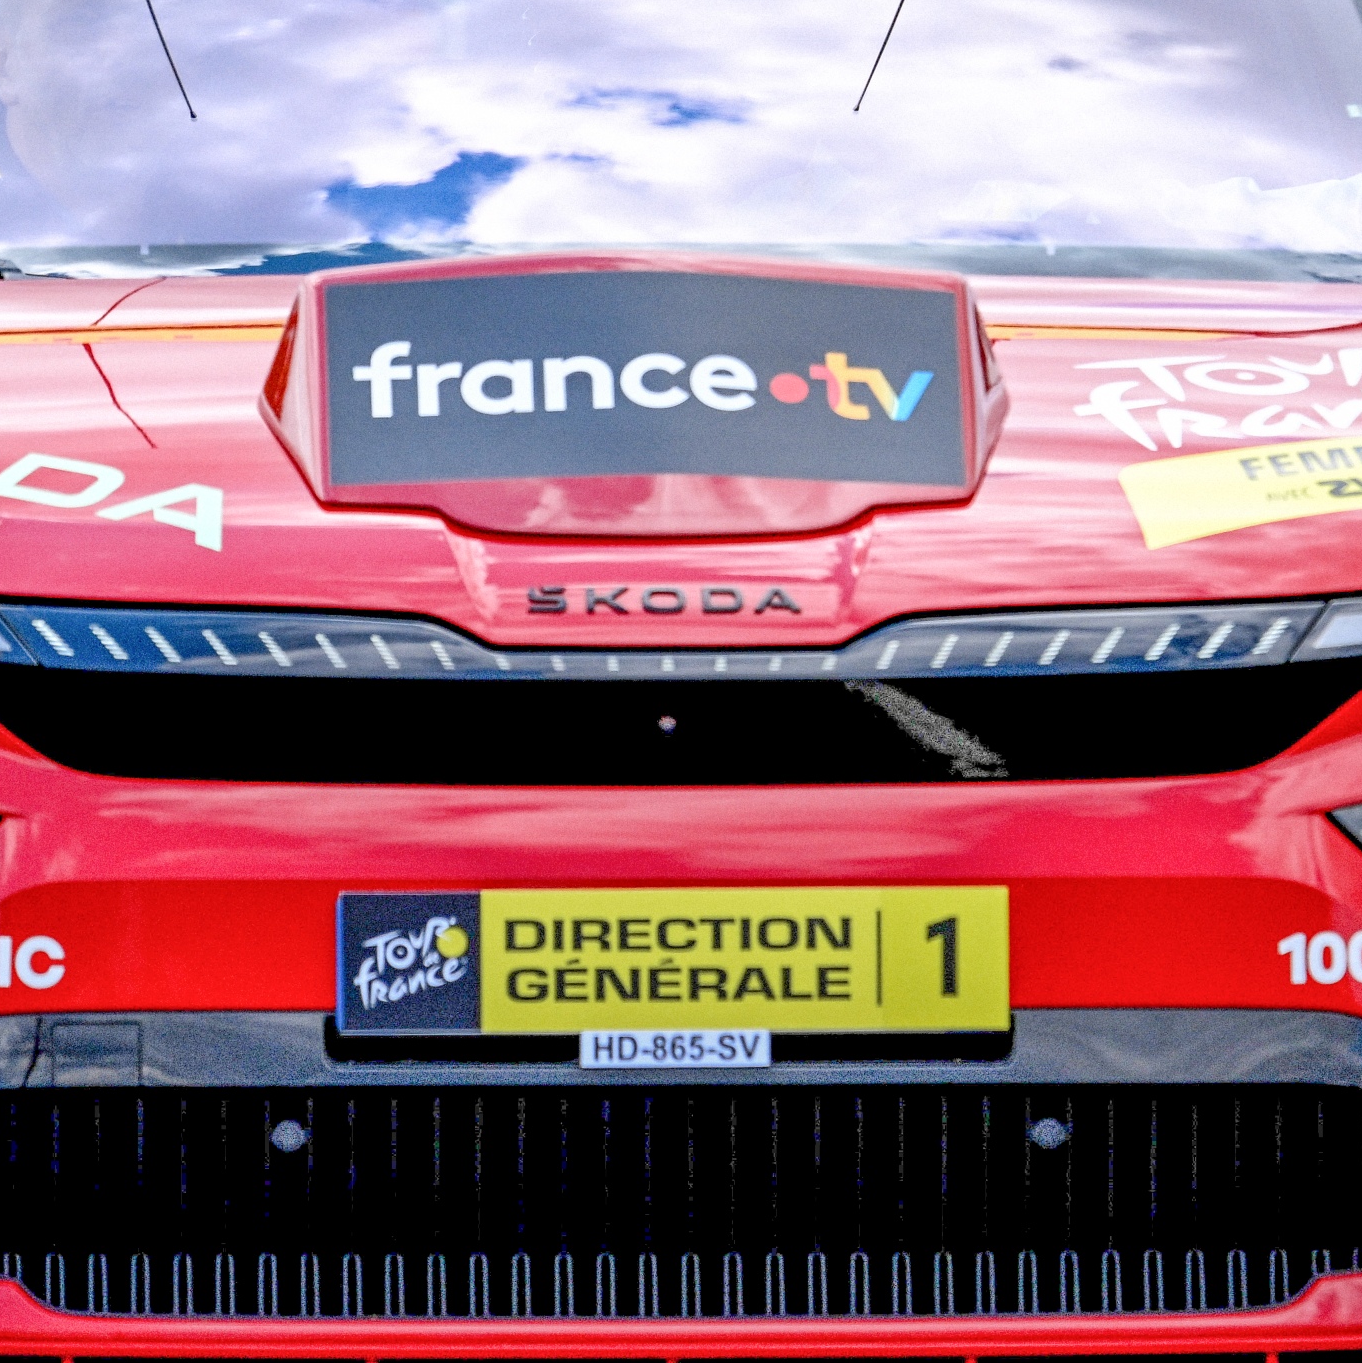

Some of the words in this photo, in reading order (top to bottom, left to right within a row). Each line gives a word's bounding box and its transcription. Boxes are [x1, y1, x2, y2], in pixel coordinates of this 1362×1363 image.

[503, 916, 853, 953] DIRECTION
[923, 916, 960, 999] 1
[506, 957, 853, 1004] GÉNÉRALE
[591, 1034, 761, 1063] HD-865-SV
